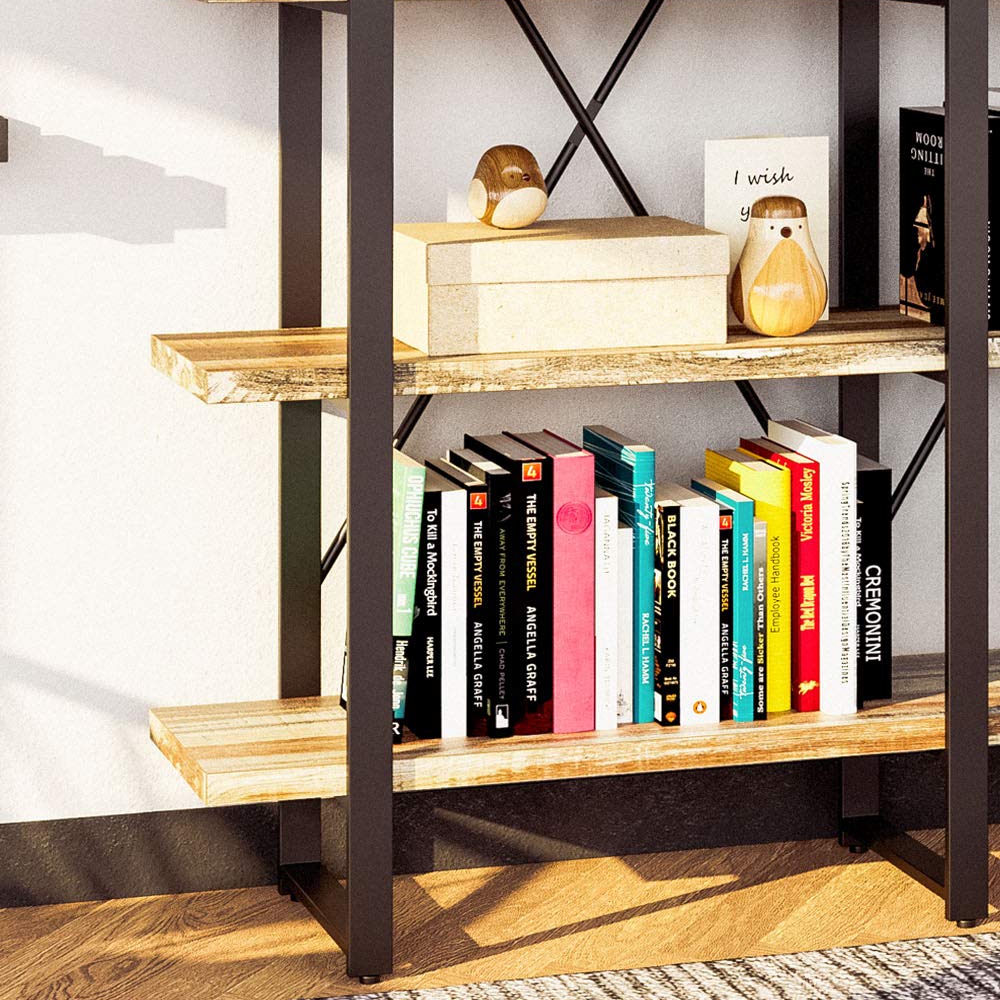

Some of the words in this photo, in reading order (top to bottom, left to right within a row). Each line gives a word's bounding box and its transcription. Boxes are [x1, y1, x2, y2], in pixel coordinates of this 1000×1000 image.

[915, 130, 944, 149] ROOM
[911, 147, 944, 166] ITTING
[734, 169, 739, 185] I
[747, 166, 794, 185] wish
[800, 467, 815, 500] Mosley
[427, 508, 438, 521] To
[526, 494, 537, 514] THE
[427, 524, 438, 541] Kill
[473, 521, 483, 539] THE
[526, 517, 537, 551] EMPTY
[667, 515, 677, 557] BLACK
[800, 504, 813, 542] Victoria
[498, 528, 506, 551] AWAY
[721, 539, 729, 554] THE
[399, 547, 415, 579] CUBE
[473, 541, 483, 573] EMPTY
[498, 553, 506, 577] FROM
[526, 553, 537, 591] VESSEL
[721, 556, 729, 582] EMPTY
[770, 535, 780, 583] Handbook
[424, 552, 438, 617] Mockingbird
[473, 574, 483, 608] VESSEL
[667, 560, 677, 598] BOOK
[498, 580, 506, 636] EVERYWHERE
[721, 584, 729, 612] VESSEL
[770, 587, 782, 633] Employee
[865, 564, 881, 662] CREMONINI
[473, 622, 483, 670] ANGELLA
[526, 606, 537, 659] ANGELLA
[641, 613, 649, 647] RACHEL
[721, 623, 729, 663] ANGELLA
[394, 640, 409, 671] Hendrik
[426, 637, 434, 664] HARPER
[498, 648, 506, 669] CHAD
[426, 665, 434, 678] LEE
[526, 663, 537, 702] GRAFF
[641, 656, 649, 684] HAMM
[721, 666, 729, 695] GRAFF
[473, 674, 483, 708] GRAFF
